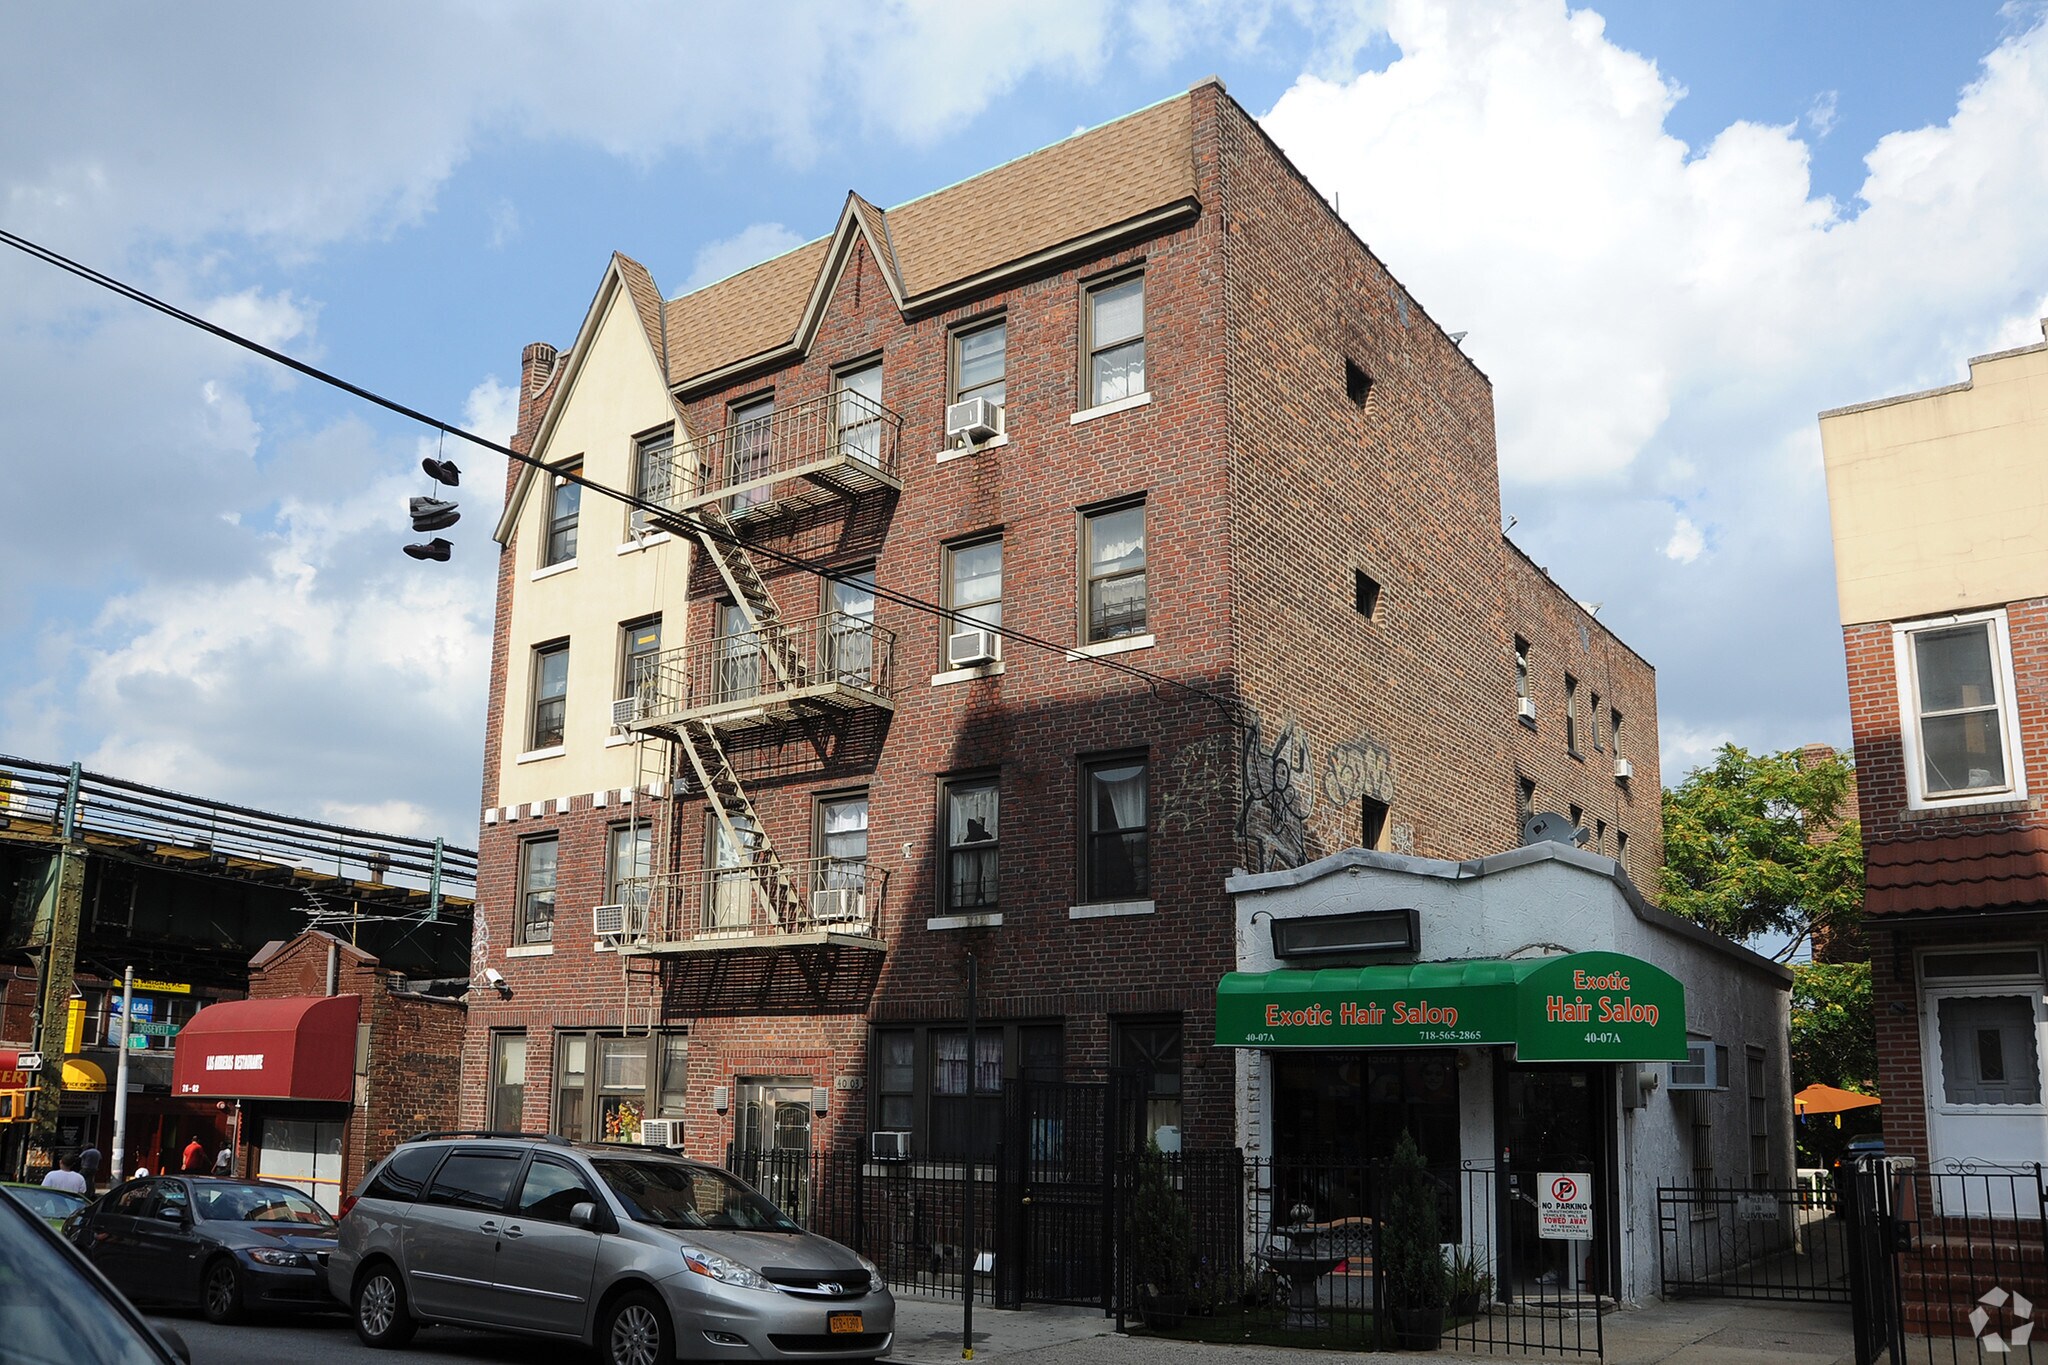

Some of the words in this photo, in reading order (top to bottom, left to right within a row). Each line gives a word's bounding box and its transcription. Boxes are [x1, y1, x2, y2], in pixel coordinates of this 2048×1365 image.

[1574, 970, 1630, 990] Exotic
[134, 1003, 149, 1011] L&A
[1547, 996, 1592, 1022] Hair
[1599, 996, 1659, 1027] Salon
[1265, 1003, 1332, 1026] Exotic
[1340, 1002, 1385, 1025] Hair
[1393, 1000, 1458, 1027] Salon
[134, 1024, 169, 1034] ROOSEVELT
[1245, 1033, 1275, 1042] 40-07A
[1419, 1031, 1481, 1040] 718-565-2865
[1584, 1033, 1621, 1043] 40-07A
